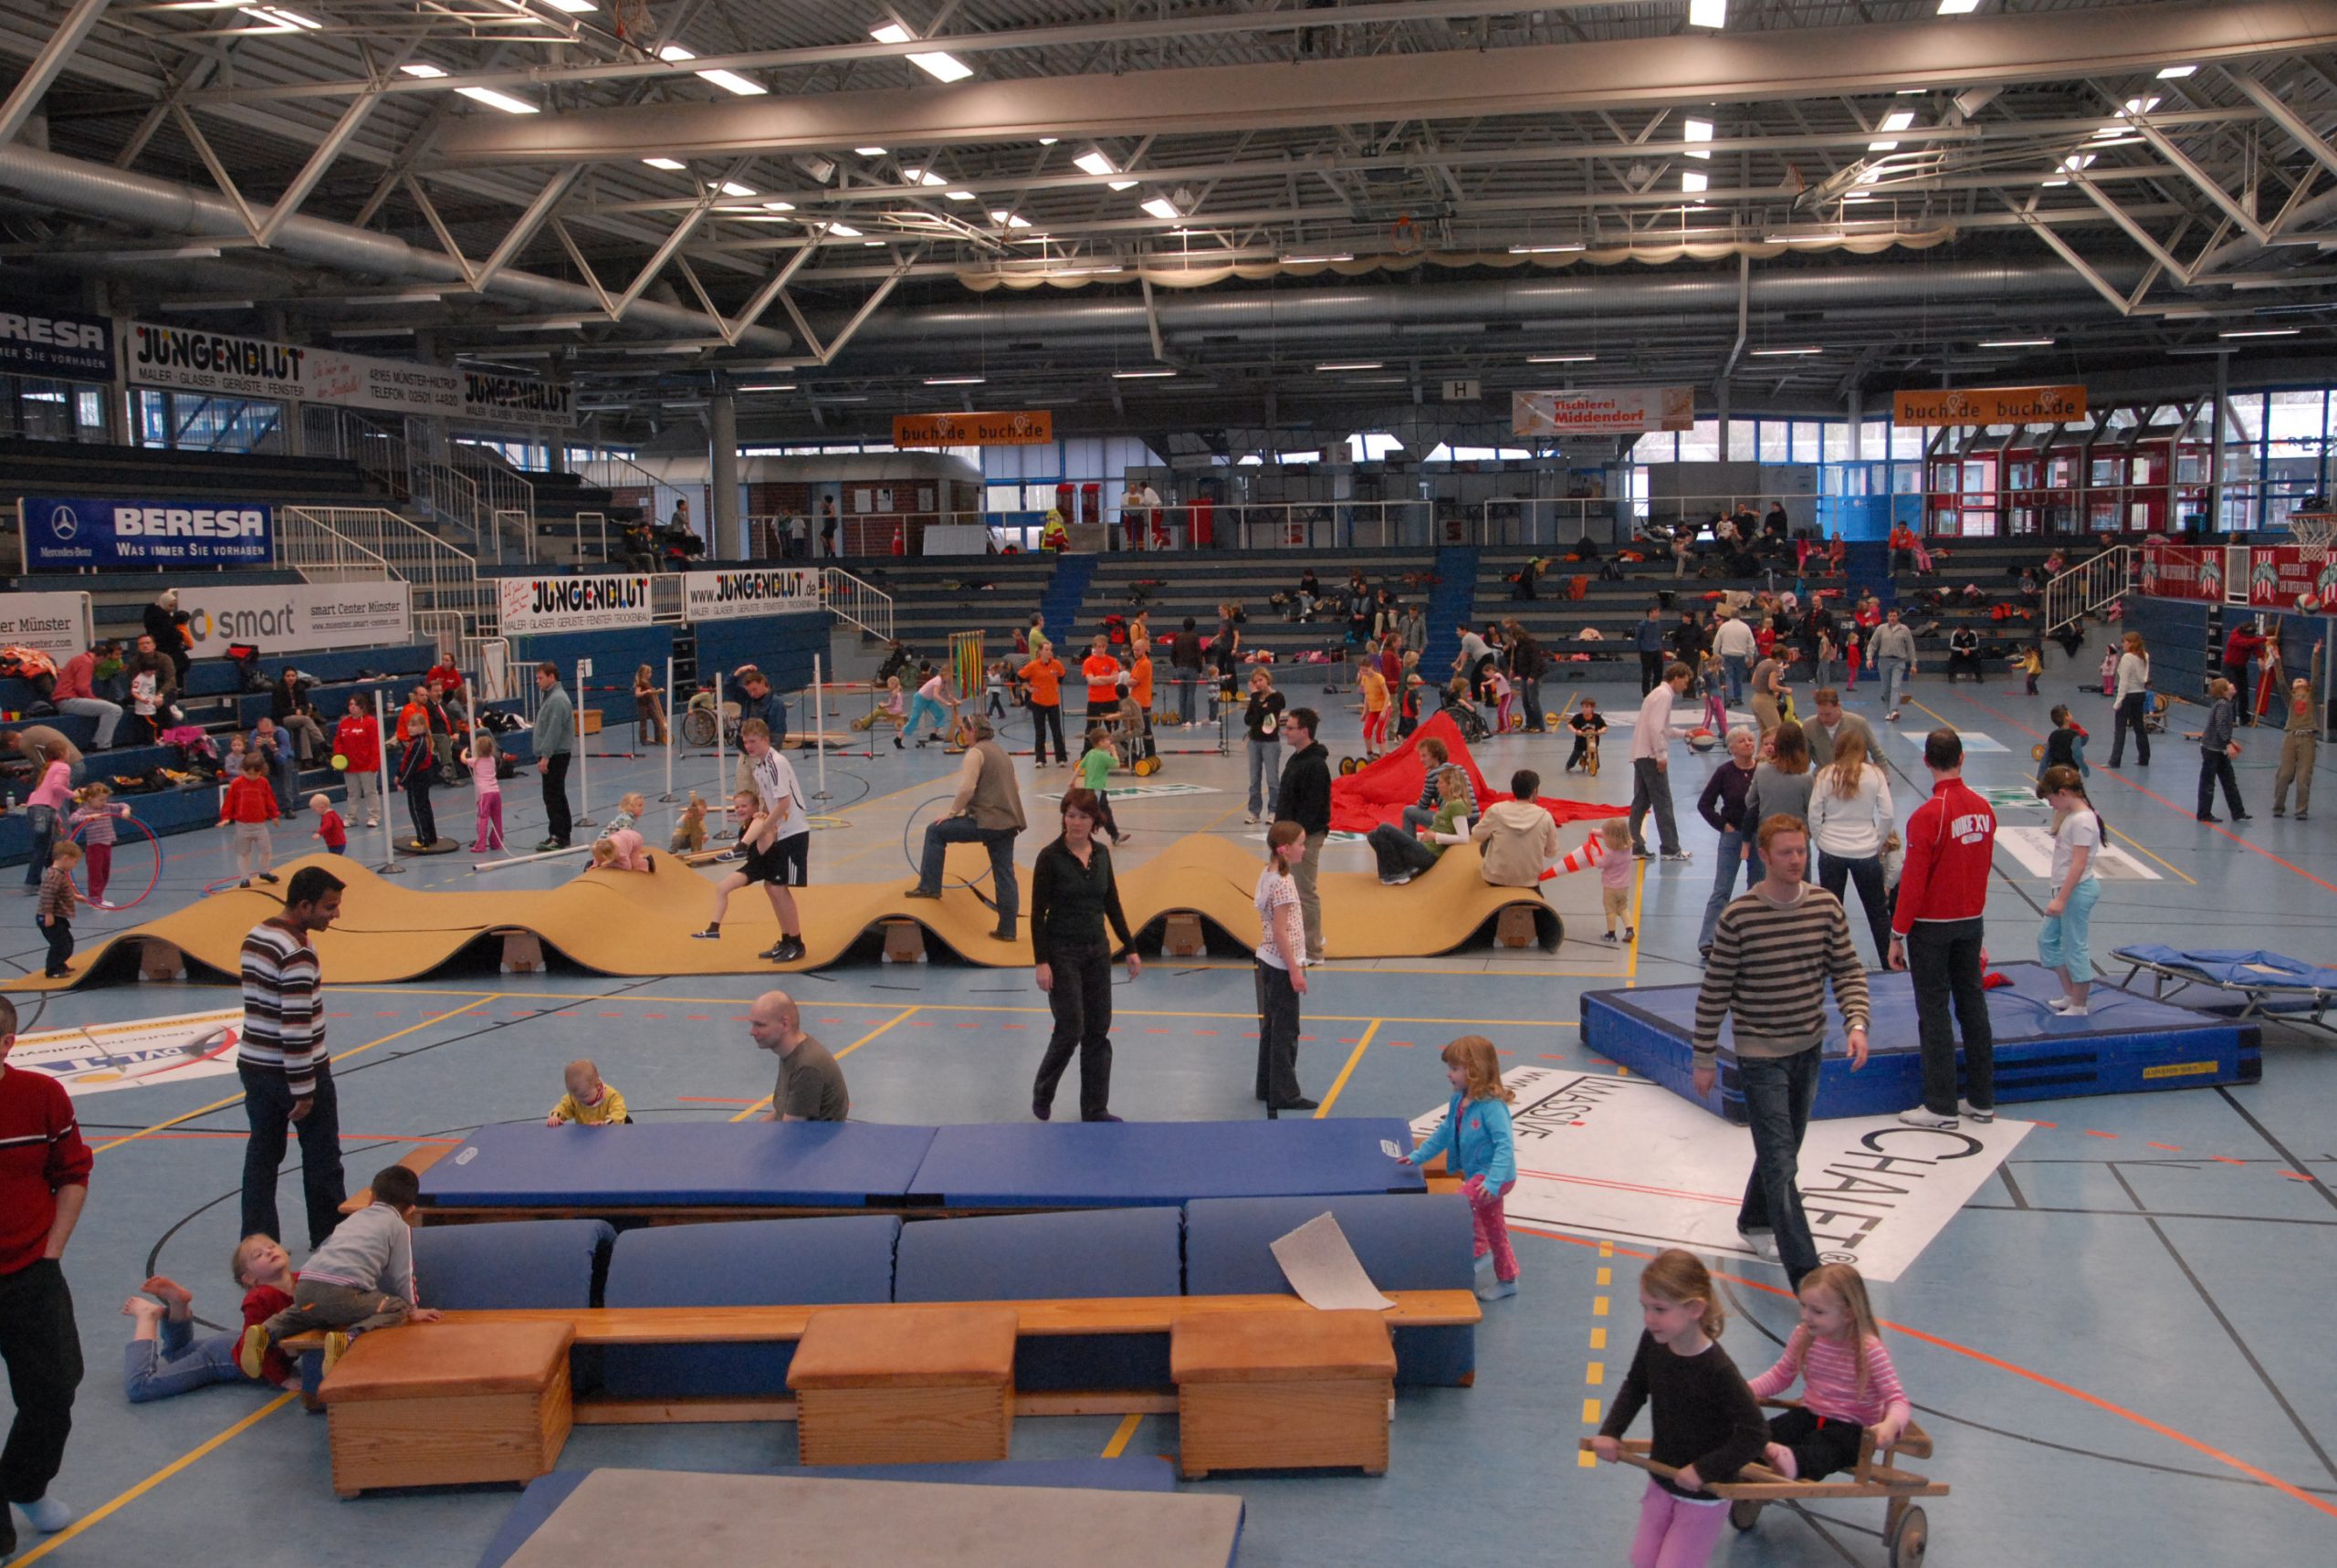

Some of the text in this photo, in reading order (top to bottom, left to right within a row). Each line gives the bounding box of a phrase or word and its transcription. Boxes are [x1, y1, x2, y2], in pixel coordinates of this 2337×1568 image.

[0, 347, 18, 358] ER
[137, 326, 304, 381] JUNGENBLUT
[139, 367, 172, 382] MALER
[180, 371, 215, 387] GLASER
[223, 377, 262, 392] GERÜSTE
[268, 383, 305, 396] FENSTER
[1454, 382, 1467, 397] H
[465, 371, 571, 413] JUNGENBLUT
[1554, 399, 1615, 410] Tischlerei
[1904, 398, 2075, 419] buch.de buch.de
[1555, 409, 1644, 423] Middendorf
[902, 423, 1043, 441] buch.de buch.de
[114, 507, 264, 538] BERESA
[40, 547, 92, 557] Mercedes-Benz
[532, 578, 648, 614] JUNGENBLUT
[310, 601, 401, 616] smart Center Münster
[19, 617, 71, 632] Münster
[218, 603, 295, 639] smart
[504, 620, 527, 631] MALER
[530, 618, 555, 629] GLASER
[587, 614, 612, 625] FENSTER
[614, 612, 650, 623] TROCKENBAU
[1952, 815, 1974, 839] NIKE
[9, 1044, 93, 1058] Volleyb
